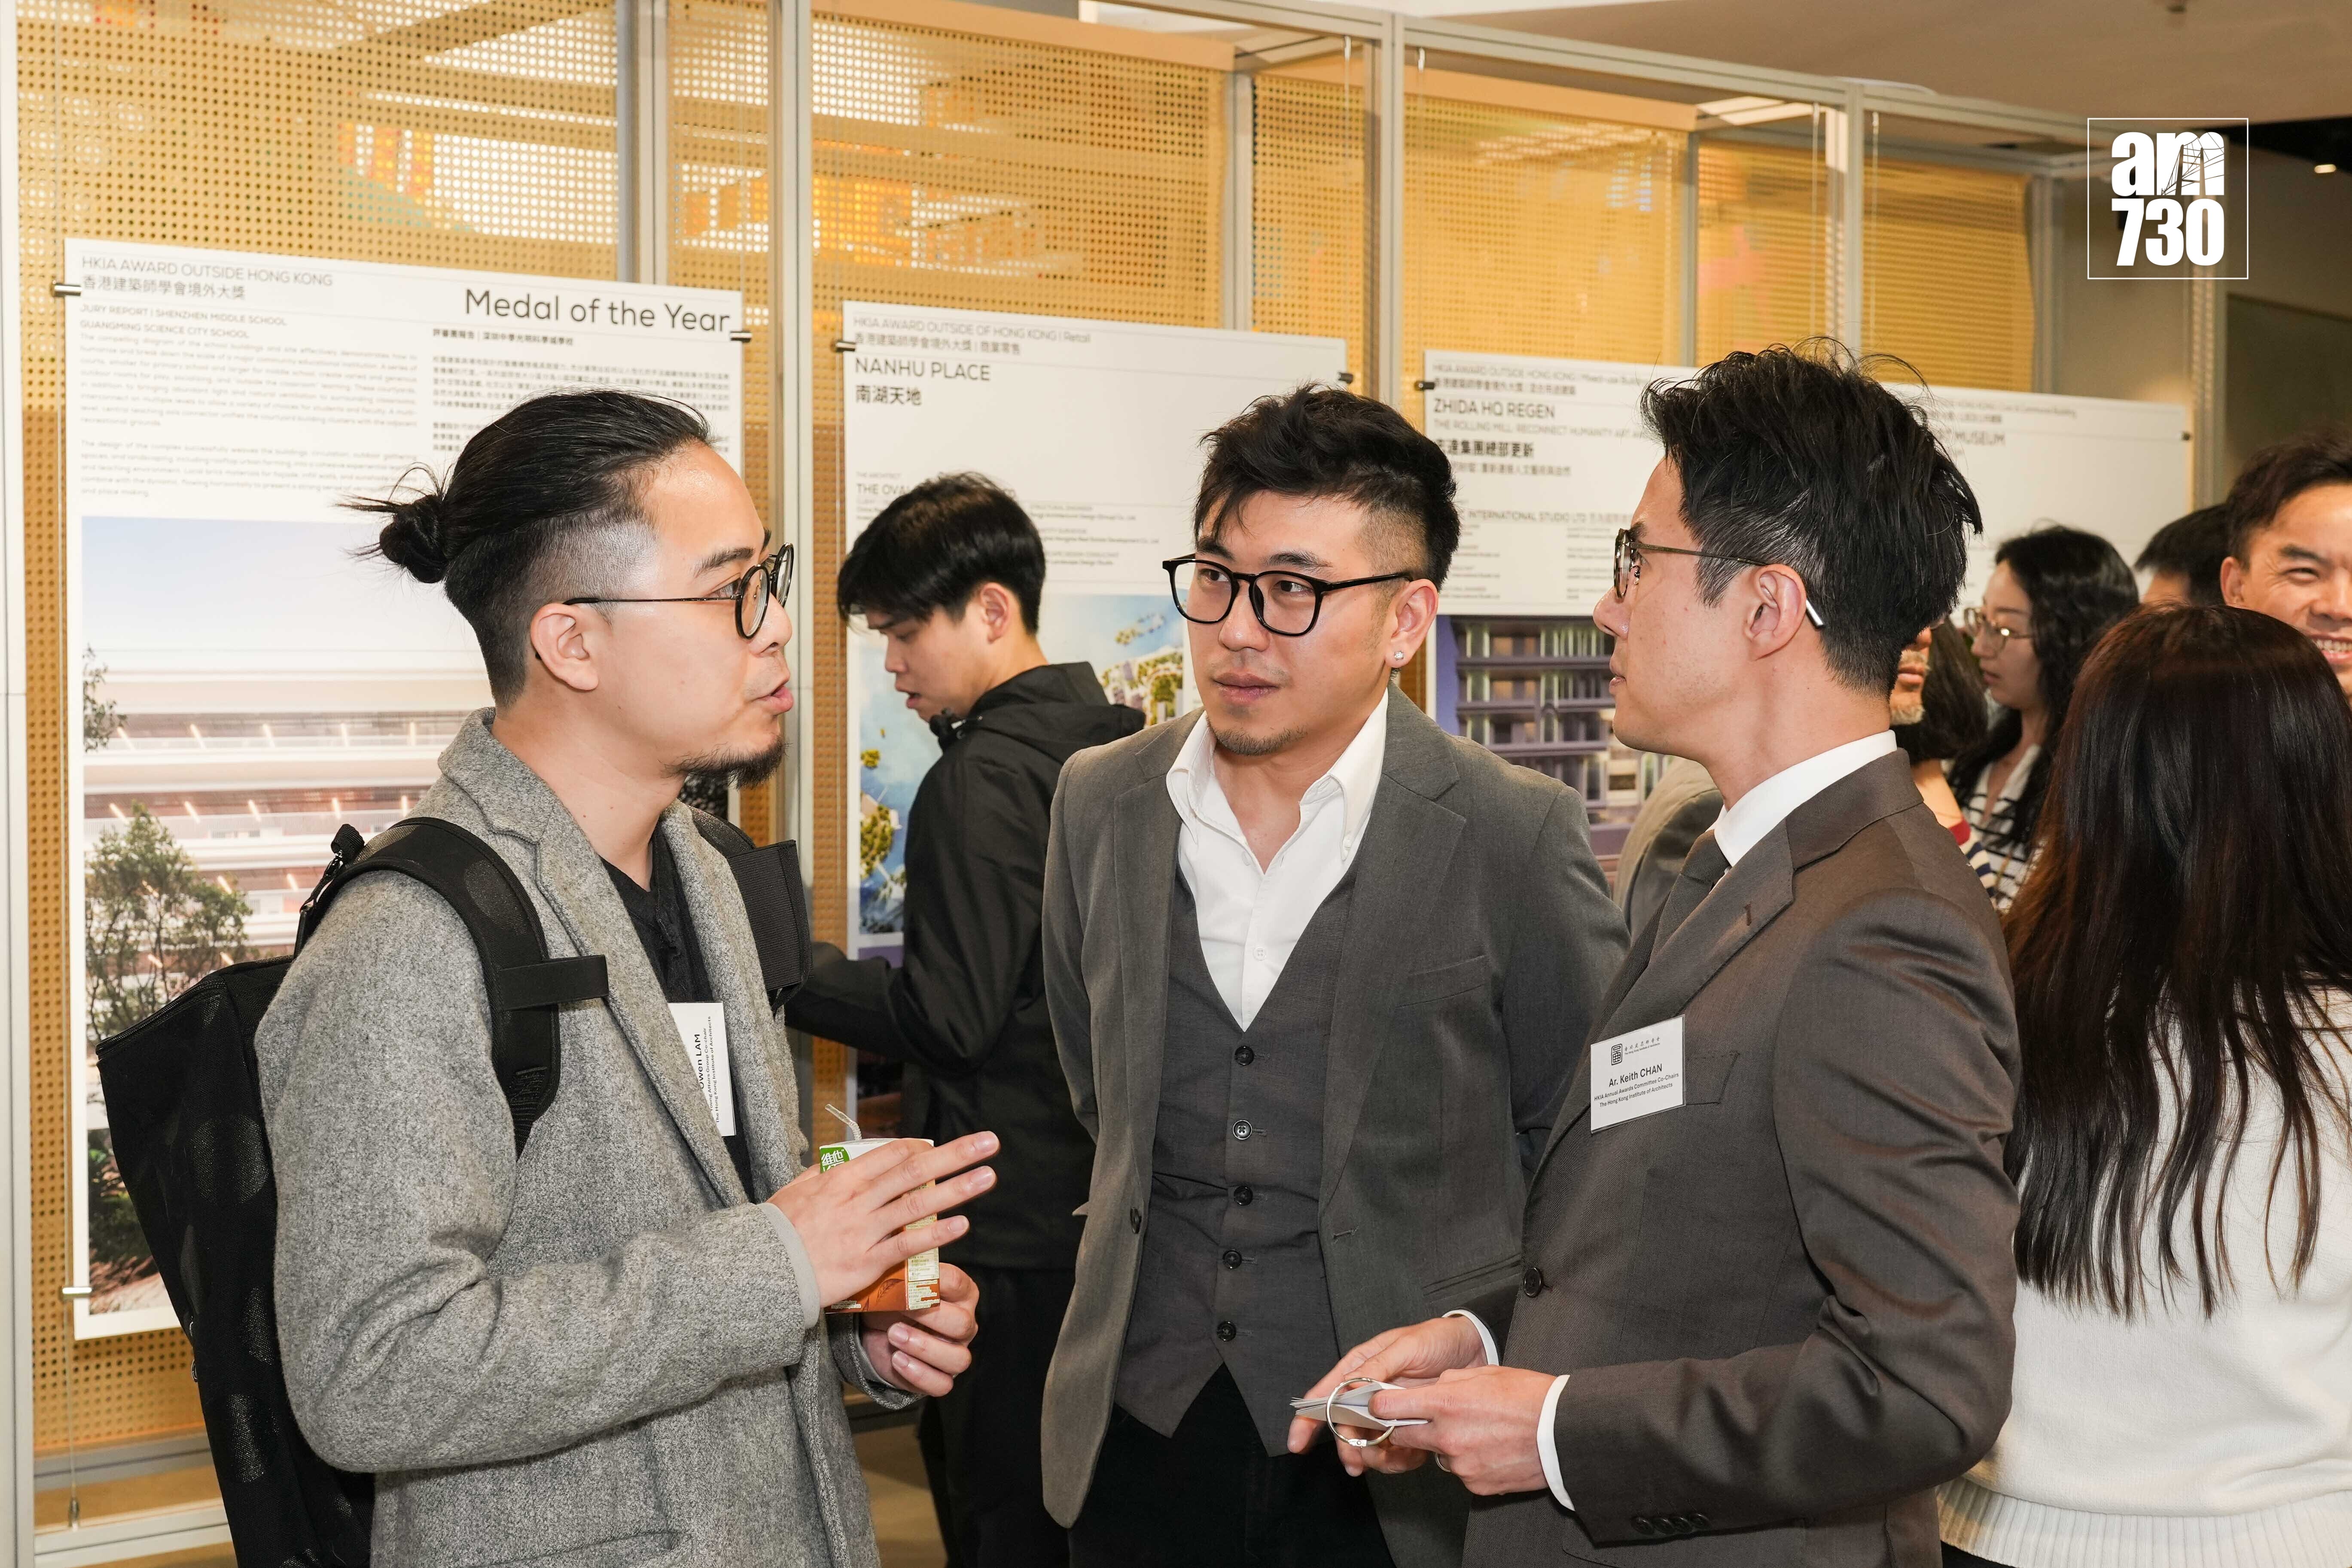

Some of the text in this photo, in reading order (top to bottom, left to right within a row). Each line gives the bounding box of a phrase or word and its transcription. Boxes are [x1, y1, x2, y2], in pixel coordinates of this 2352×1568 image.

[82, 256, 333, 286] HKIA AWARD OUTSIDE HONG KONG
[80, 304, 287, 326] JURY REPORT SHENZHEN MIDDLE SCHOOL
[466, 289, 730, 332] Medal of the Year
[80, 320, 249, 338] GUANGMING SCIENCE CITY SCHOOL
[853, 318, 1091, 342] HKIA AWARD OUTSIDE OF HONG KONG Retail
[856, 358, 990, 381] NANHU PLACE
[856, 385, 922, 405] 南湖天地
[1434, 398, 1555, 418] ZHIDA HQ REGEN
[857, 484, 878, 494] THE
[1604, 1090, 1618, 1098] Annual
[1619, 1086, 1633, 1094] Awards
[1634, 1079, 1657, 1089] Committee
[1657, 1073, 1679, 1083] Co-Chairs
[1609, 1063, 1662, 1087] Ar. Keith CHAN
[1629, 1090, 1646, 1099] Institute
[1651, 1083, 1673, 1093] Architects
